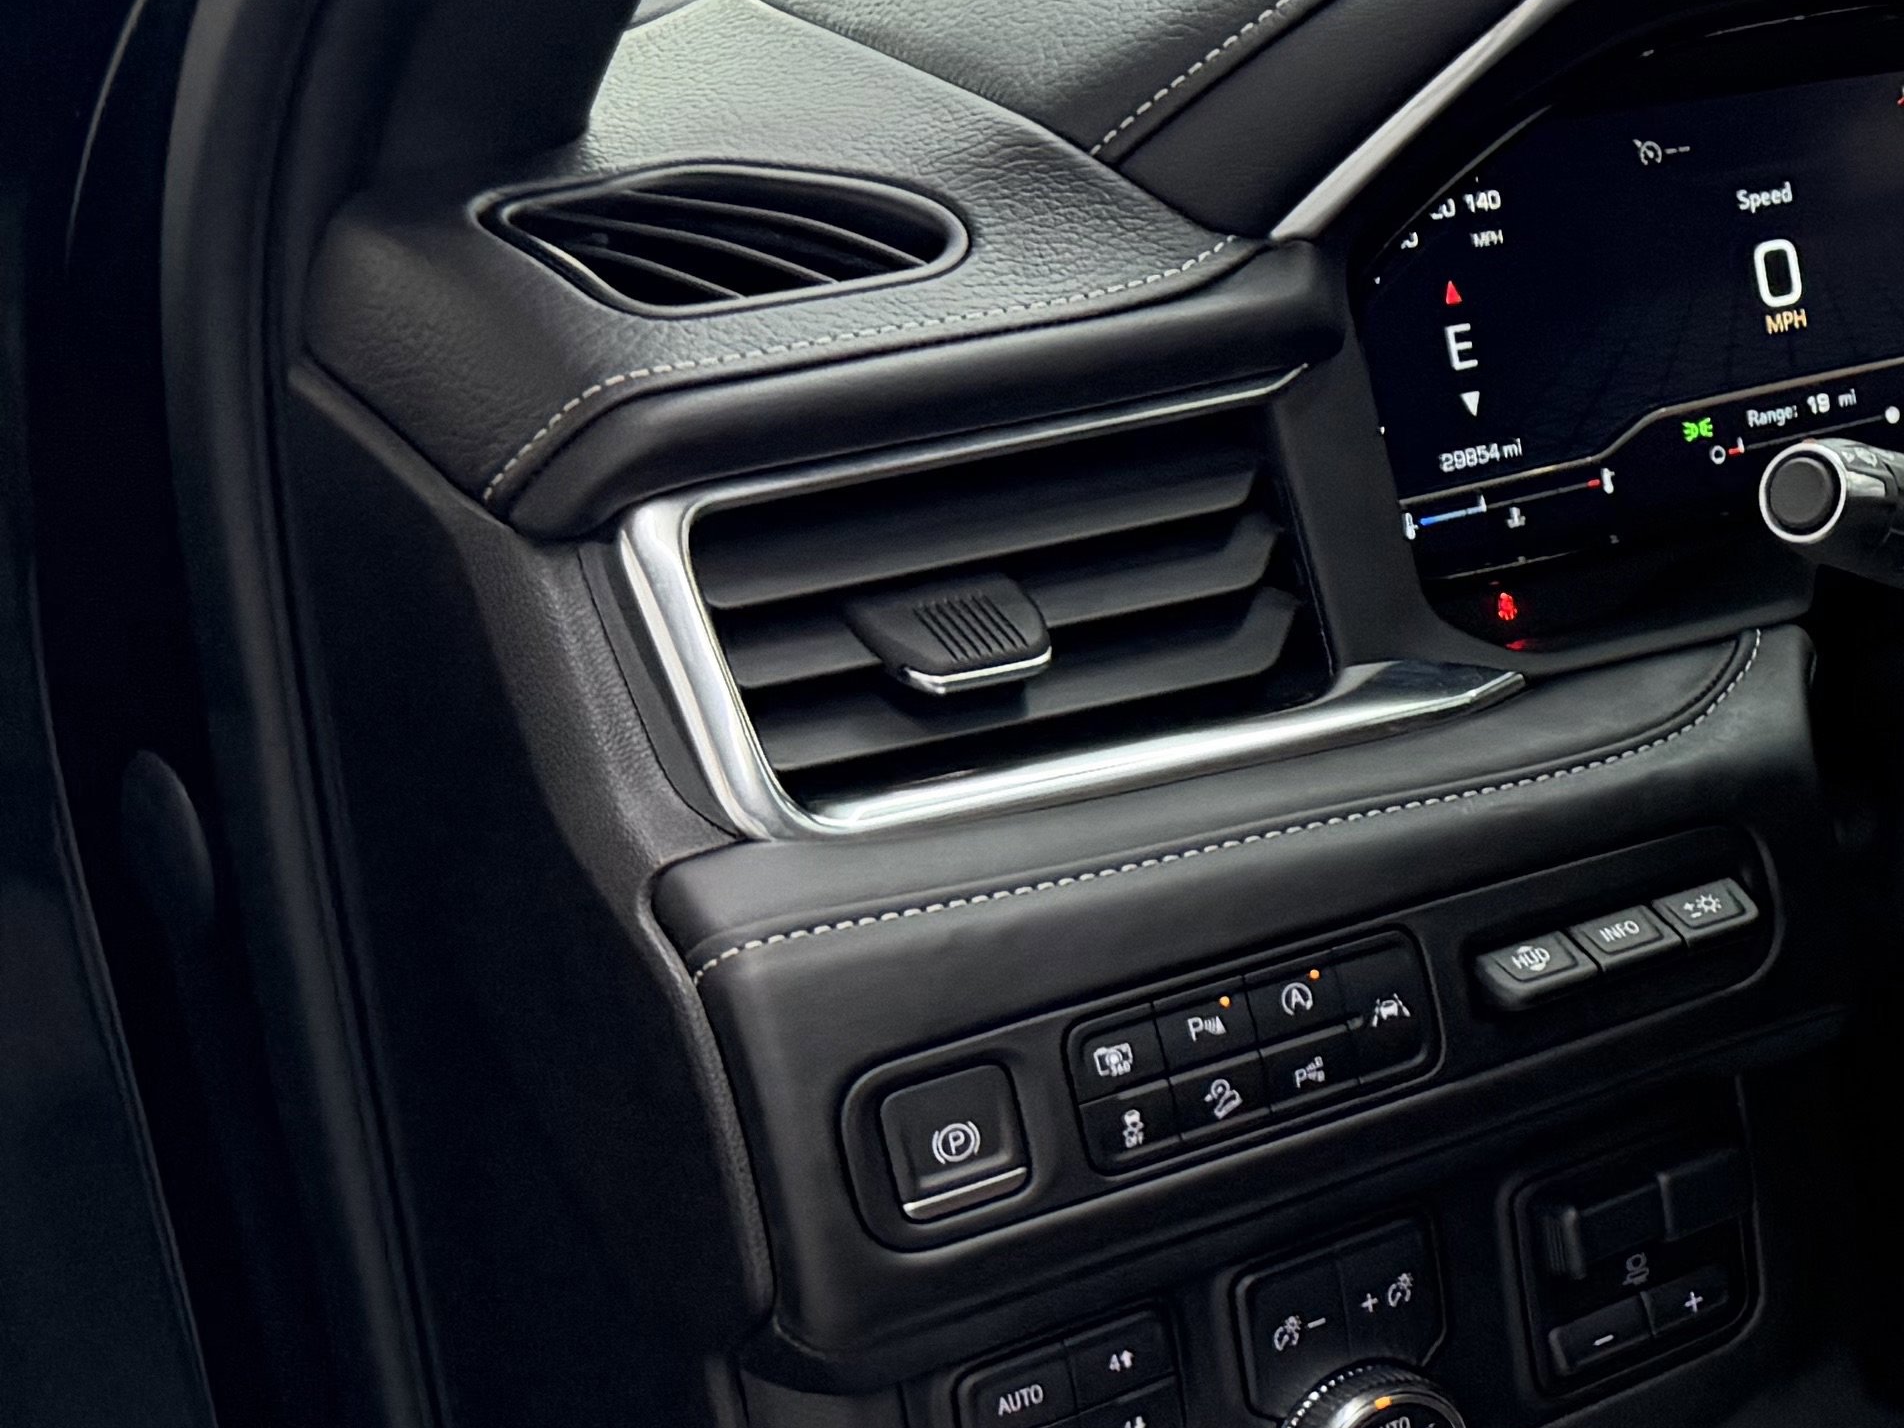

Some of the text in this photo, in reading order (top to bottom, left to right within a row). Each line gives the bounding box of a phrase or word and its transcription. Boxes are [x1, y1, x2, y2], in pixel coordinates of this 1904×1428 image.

[1463, 189, 1501, 213] 140
[1736, 181, 1793, 214] Speed
[1754, 239, 1802, 307] 0
[1765, 308, 1807, 335] MPH
[1444, 322, 1479, 371] E
[1746, 388, 1857, 428] Range: 19 mi
[1502, 437, 1524, 459] mi
[1598, 919, 1641, 943] INFO
[1510, 946, 1551, 970] HUD
[998, 1383, 1044, 1416] AUTO
